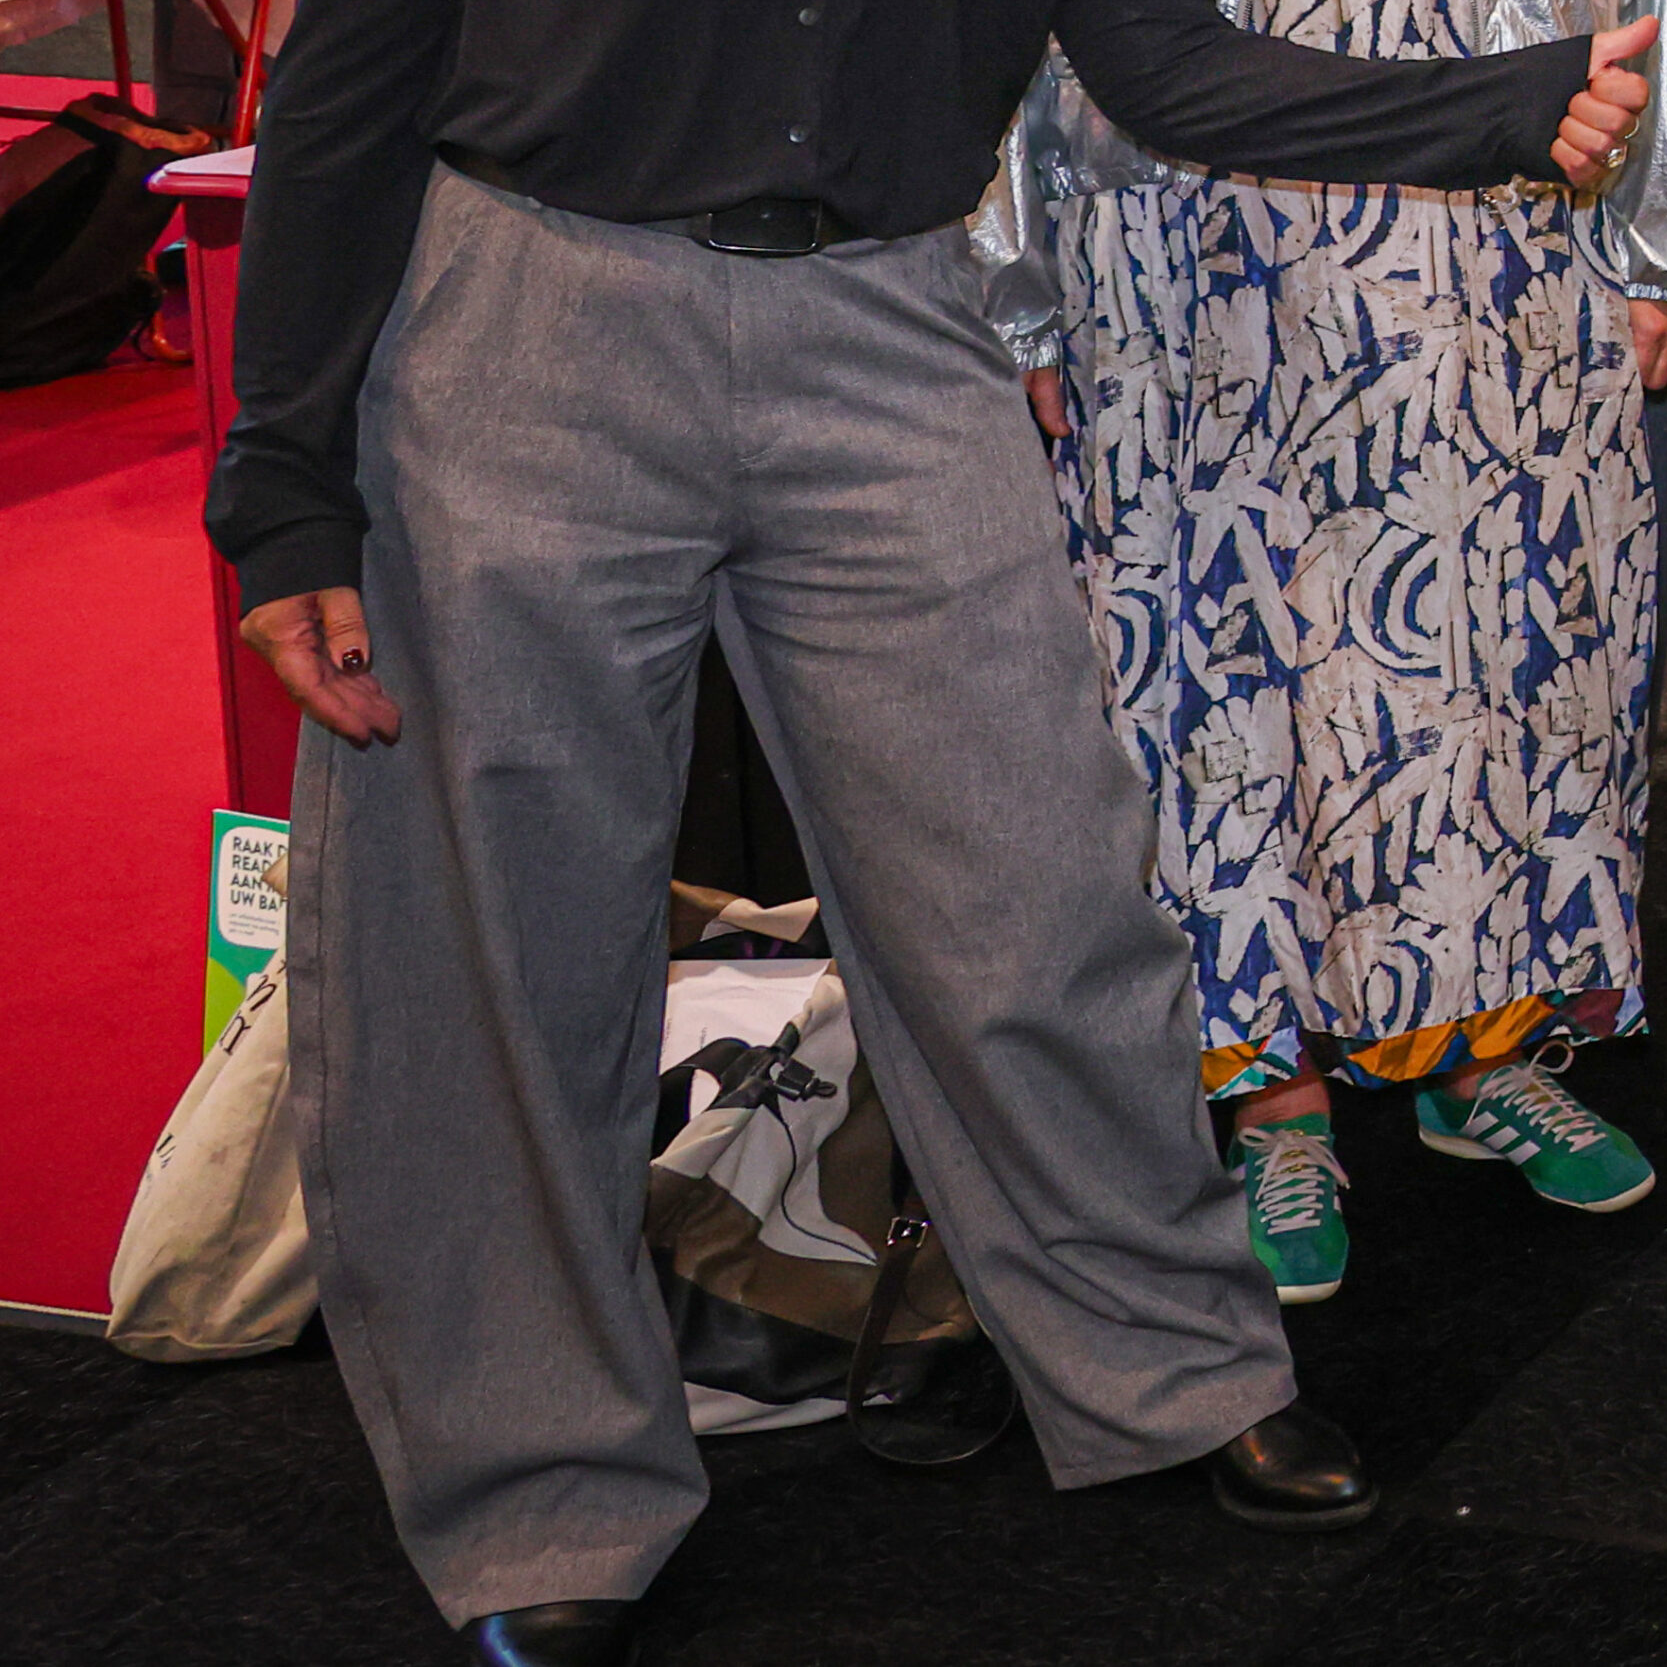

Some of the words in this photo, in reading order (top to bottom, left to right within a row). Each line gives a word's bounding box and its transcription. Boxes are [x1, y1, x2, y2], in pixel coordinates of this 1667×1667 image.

[231, 836, 273, 858] RAAK
[230, 872, 262, 891] AAN
[230, 890, 255, 908] UW
